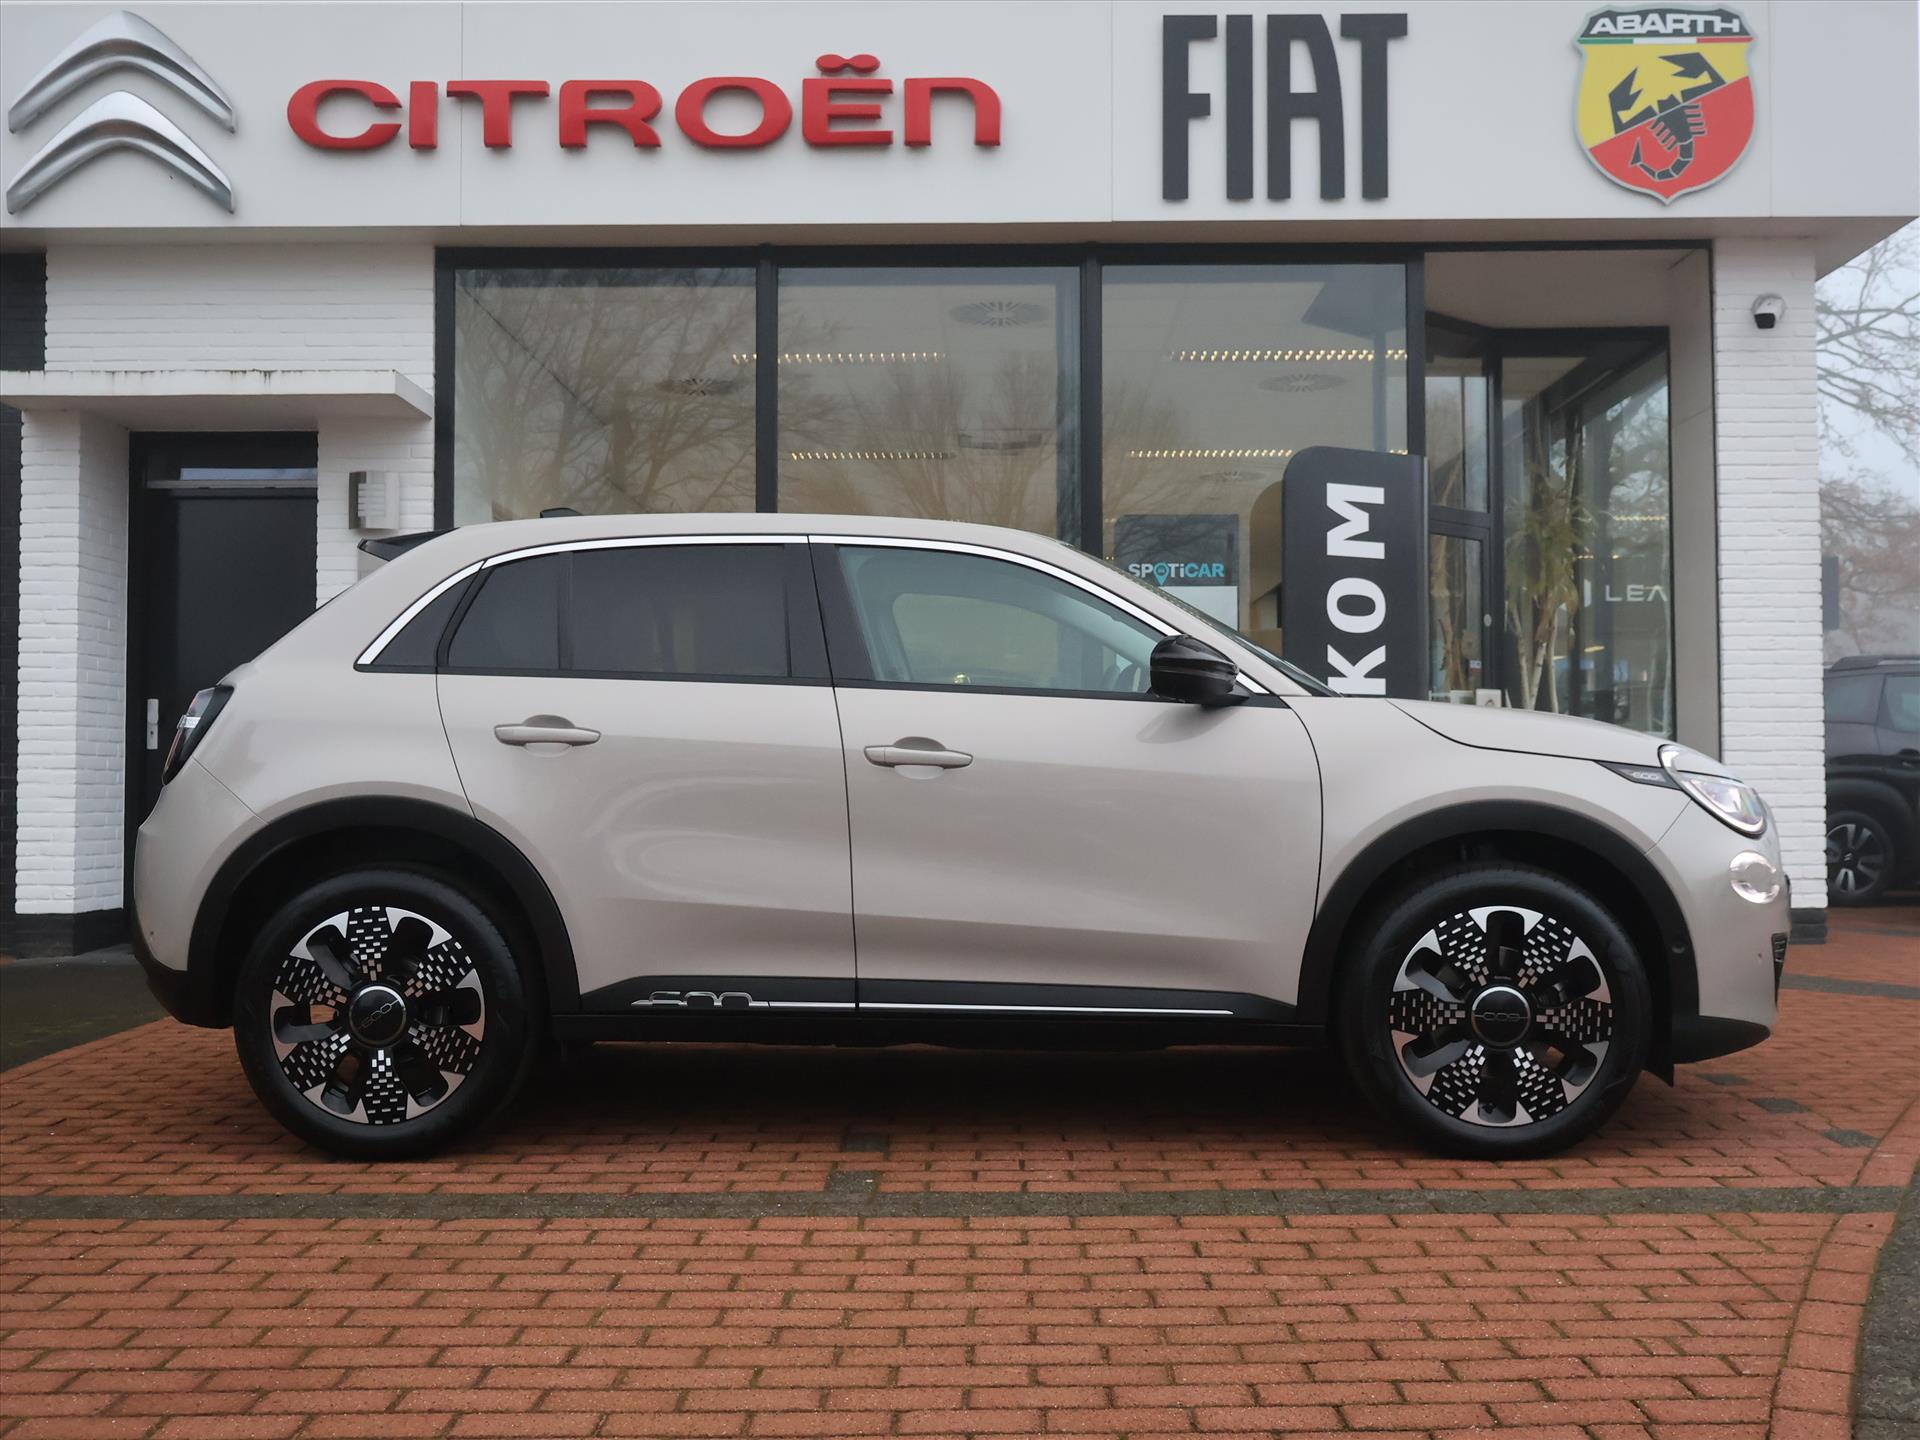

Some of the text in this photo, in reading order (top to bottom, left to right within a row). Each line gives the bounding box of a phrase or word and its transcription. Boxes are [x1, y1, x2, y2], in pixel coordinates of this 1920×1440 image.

[1589, 13, 1741, 35] ABARTH
[287, 54, 1001, 149] CITROËN
[1163, 13, 1408, 201] FIAT
[1325, 482, 1387, 696] KOM
